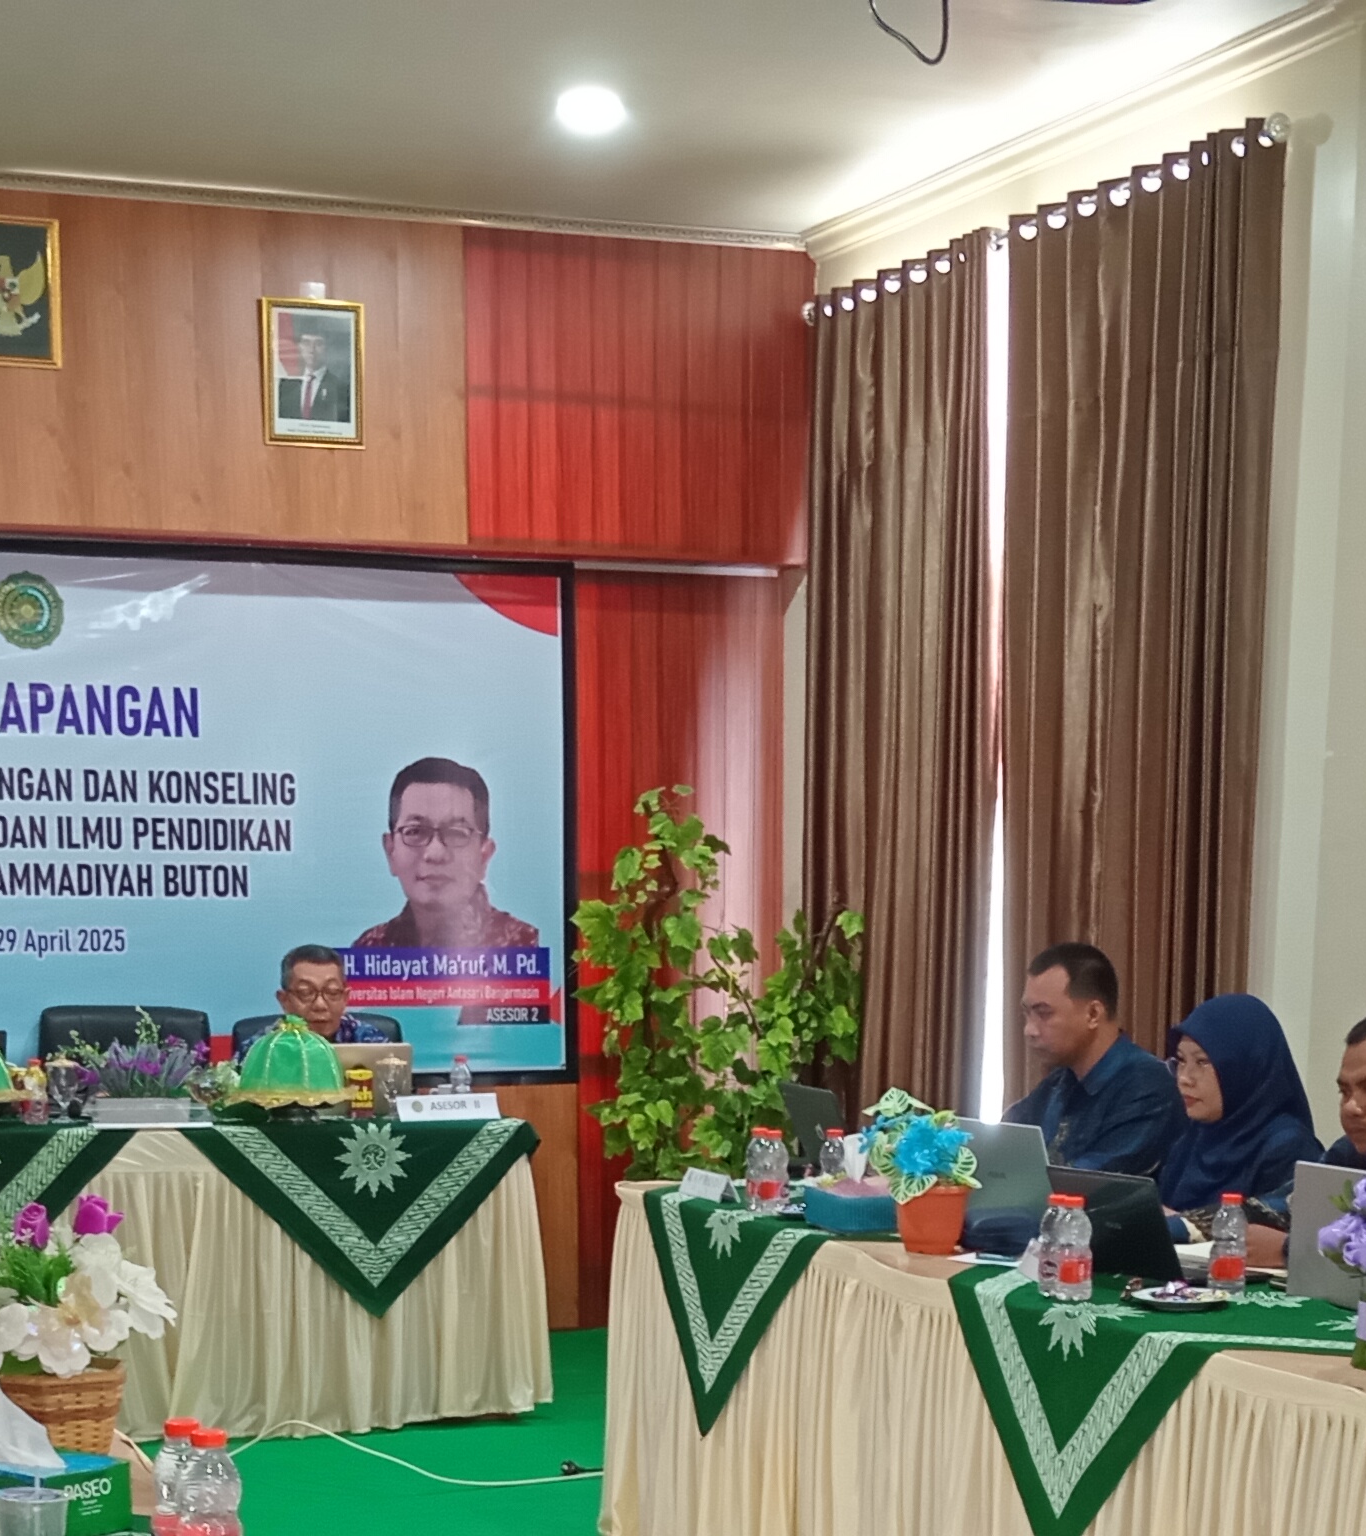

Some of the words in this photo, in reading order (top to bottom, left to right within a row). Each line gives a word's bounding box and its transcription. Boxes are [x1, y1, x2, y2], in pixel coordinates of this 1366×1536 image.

[84, 768, 138, 803] DAN
[148, 769, 296, 806] KONSELING
[56, 815, 122, 850] ILMU
[132, 817, 292, 852] PENDIDIKAN
[163, 864, 250, 898] BUTON
[23, 929, 72, 957] April
[77, 928, 126, 952] 2025
[343, 954, 360, 976] H.
[364, 953, 429, 981] Hidayat
[433, 954, 489, 978] Ma'ruf,
[492, 955, 512, 976] M.
[516, 953, 542, 976] Pd.
[348, 986, 388, 1001] iversitas
[388, 986, 415, 1001] Islam
[416, 986, 446, 1004] Negeri
[446, 986, 484, 1001] Antasari
[485, 984, 540, 1003] Banjarmasin
[486, 1007, 529, 1023] ASESOR
[531, 1007, 539, 1022] 2
[430, 1100, 468, 1111] ASESOR
[63, 1476, 113, 1501] PASEO
